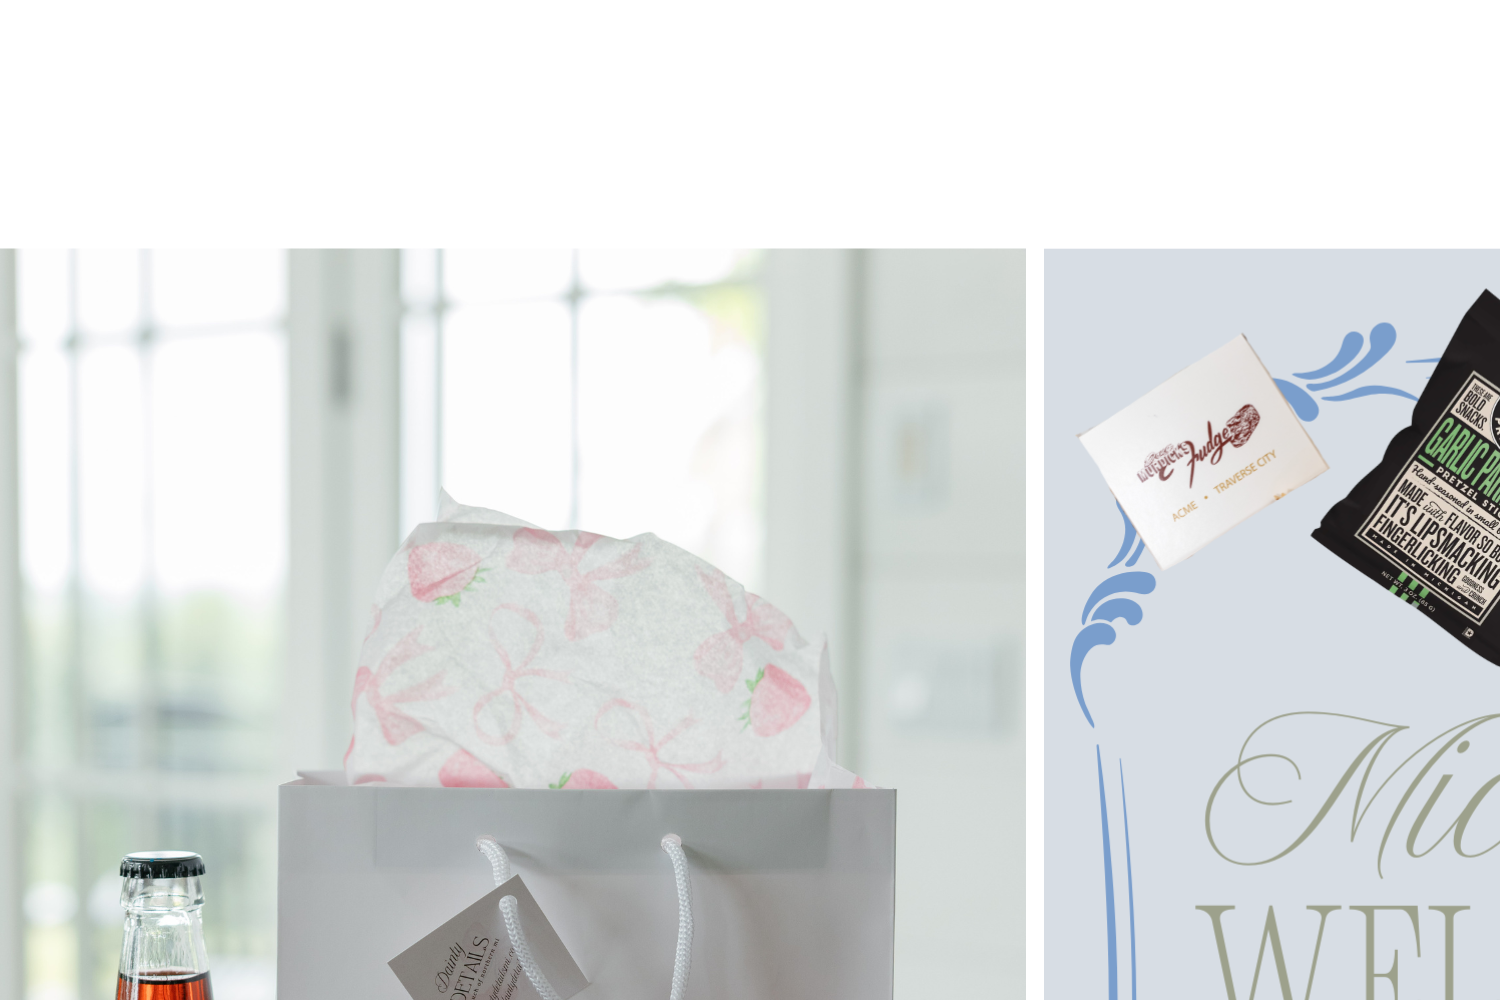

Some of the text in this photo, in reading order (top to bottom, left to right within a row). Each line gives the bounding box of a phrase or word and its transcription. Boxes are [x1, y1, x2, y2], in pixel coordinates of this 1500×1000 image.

[1455, 402, 1488, 431] SNACKS.
[1464, 390, 1487, 412] BOLD
[1424, 417, 1490, 481] GARLIC
[1172, 463, 1258, 522] ACME TRAVERSE
[1411, 464, 1469, 509] Hand-seasoned
[1436, 467, 1480, 501] PRETZEL
[1384, 494, 1417, 526] IT'S
[1398, 479, 1428, 507] MADE
[1444, 512, 1480, 546] FLAVOR
[1372, 513, 1461, 585] FINGERLICKING
[435, 942, 467, 994] Dainty
